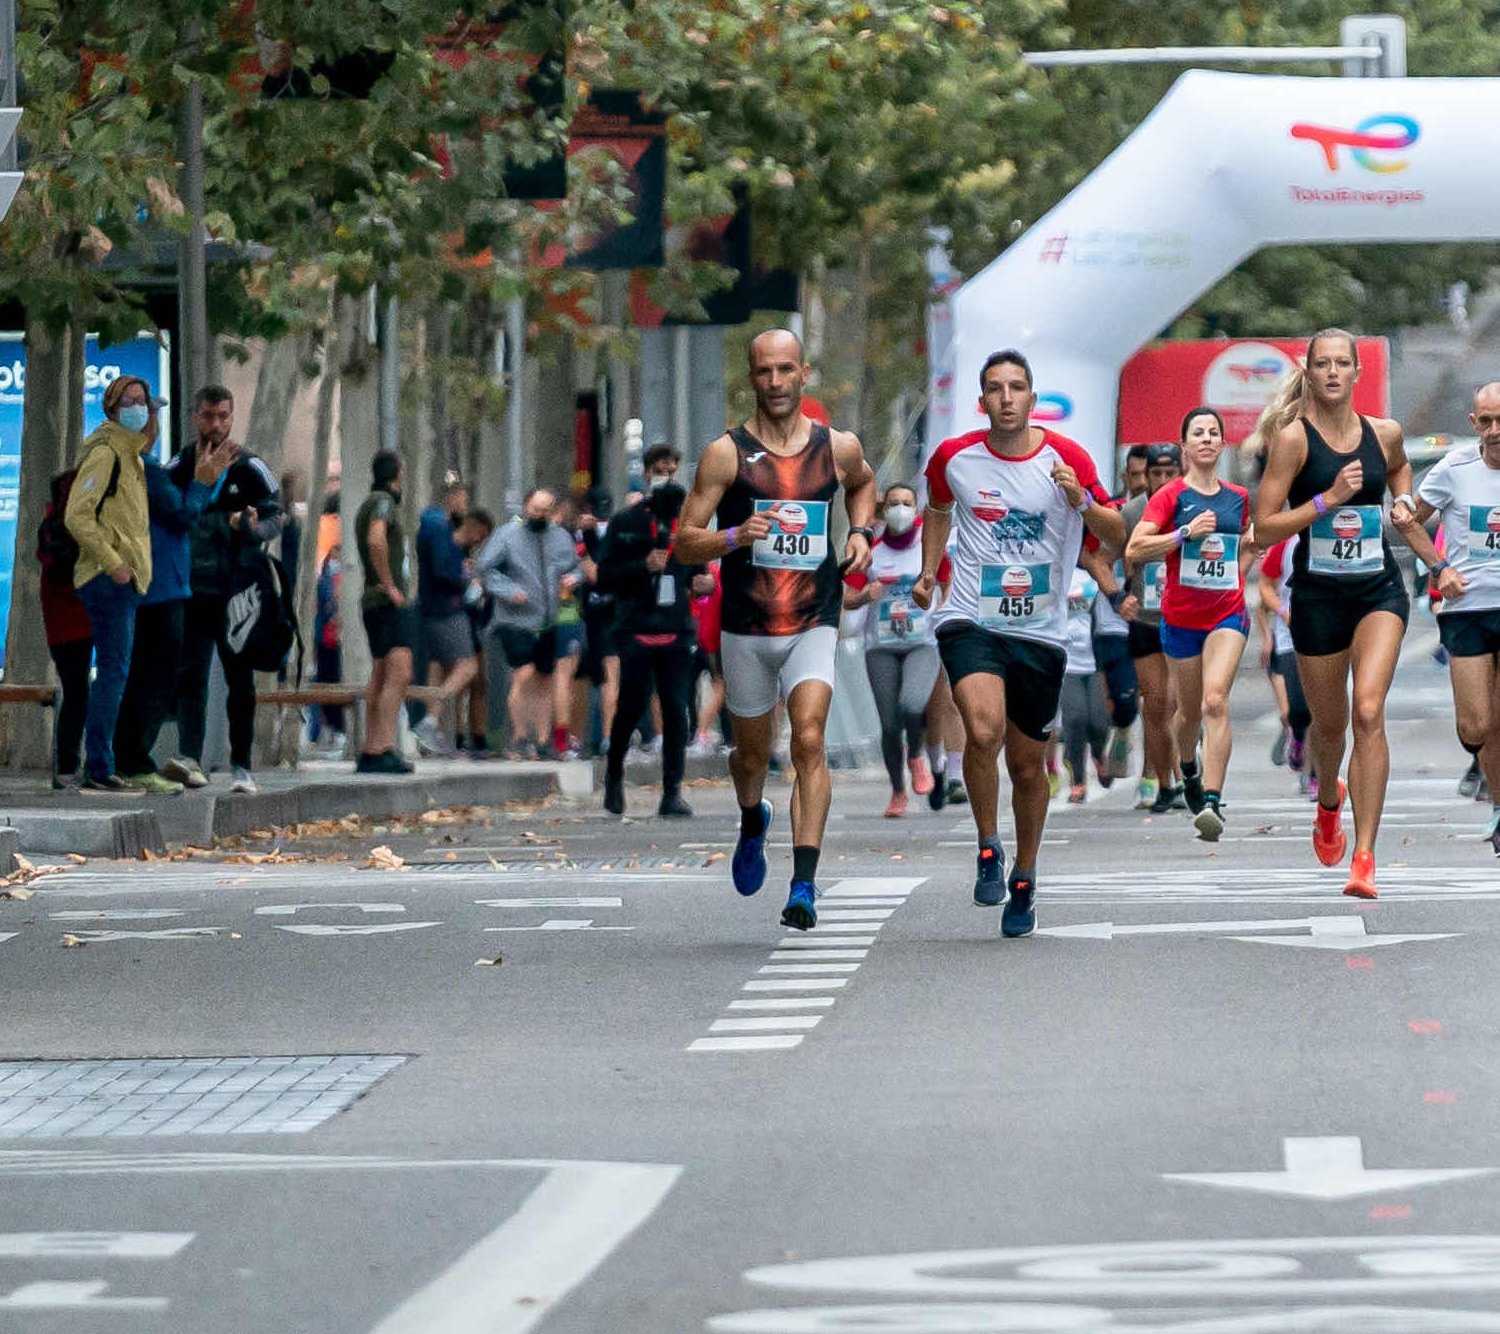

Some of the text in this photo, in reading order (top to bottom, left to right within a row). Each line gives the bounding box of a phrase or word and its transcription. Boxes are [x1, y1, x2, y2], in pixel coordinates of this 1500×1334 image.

[773, 535, 810, 556] 430
[1332, 539, 1363, 560] 421
[1197, 560, 1226, 578] 445
[998, 596, 1035, 617] 455
